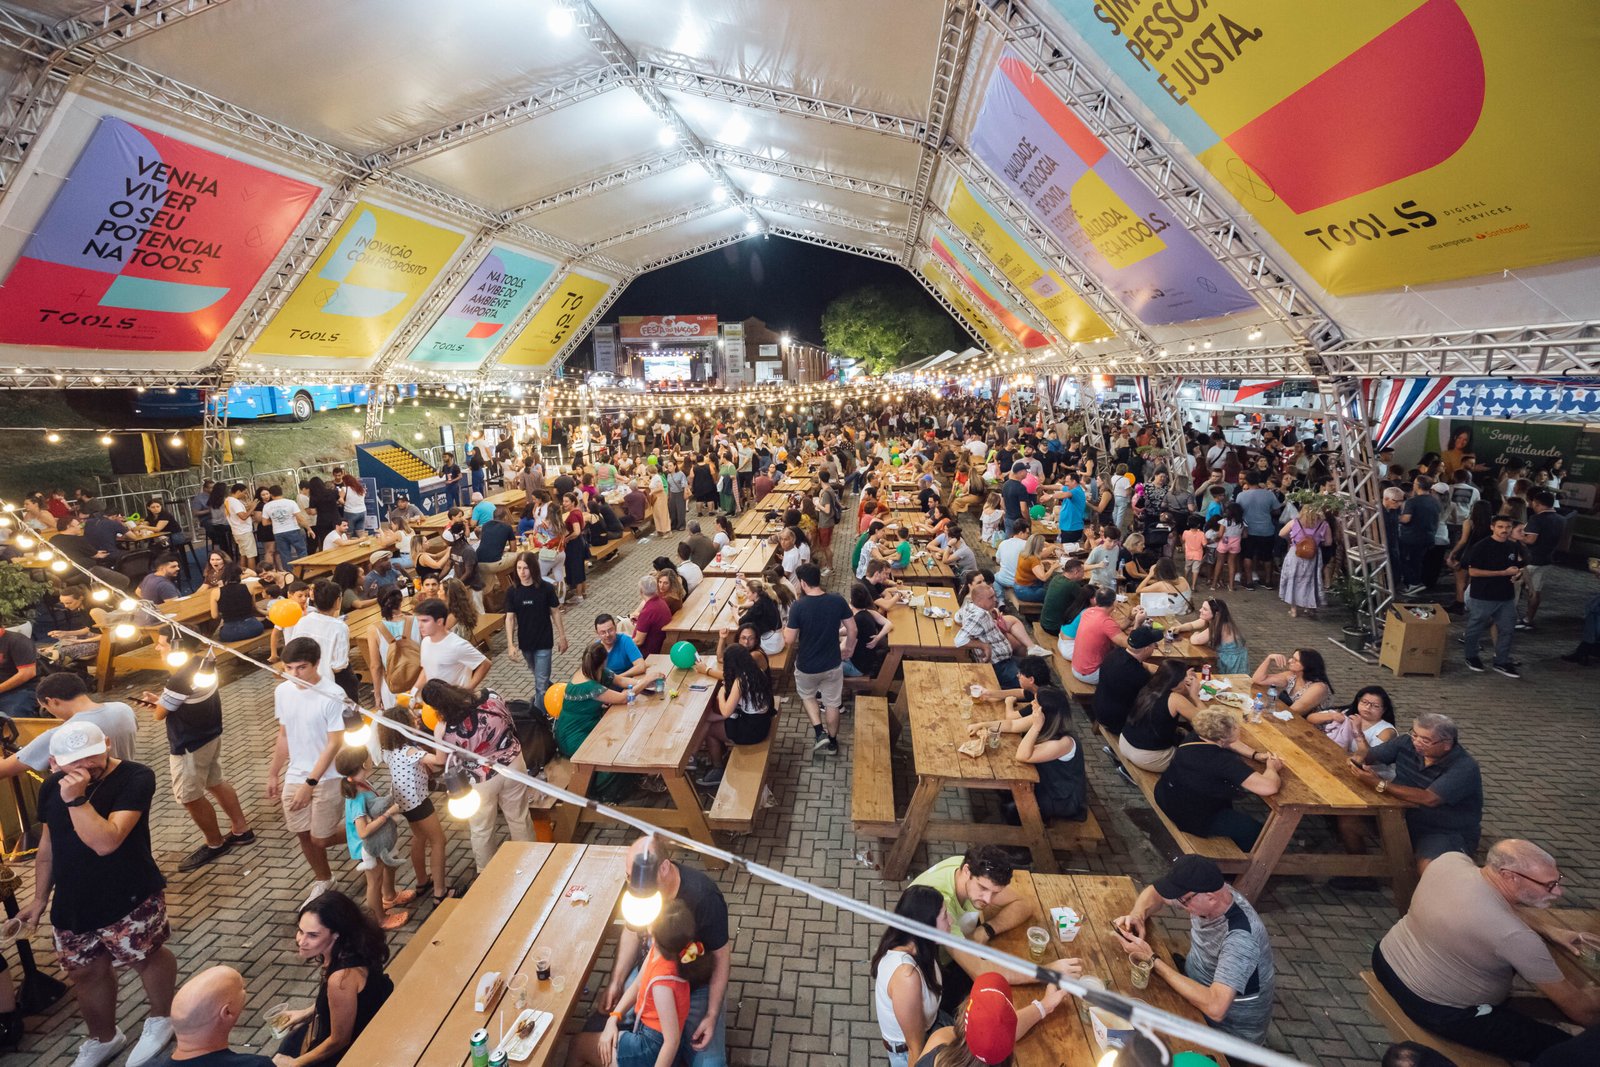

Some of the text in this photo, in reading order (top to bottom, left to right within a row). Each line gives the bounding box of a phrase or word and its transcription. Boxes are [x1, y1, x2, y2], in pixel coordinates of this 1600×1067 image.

[1125, 0, 1208, 72] PESSO
[1157, 13, 1263, 106] E JUSTA.
[1004, 136, 1041, 184] QUALIDADE,
[138, 156, 218, 197] VENHA
[1019, 154, 1060, 199] TECNOLOGIA
[126, 177, 197, 212] VIVER
[1040, 184, 1068, 211] PONTA
[109, 200, 186, 231] O SEU
[1443, 200, 1487, 217] DIGITAL
[1120, 212, 1171, 246] TOOLS.
[1304, 200, 1437, 251] TOOLS
[1484, 223, 1531, 239] Santander
[95, 219, 223, 259] POTENCIAL
[355, 235, 413, 260] INOVAÇÃO
[82, 239, 204, 274] NA TOOLS.
[347, 250, 428, 276] COM PROPÓSITO
[486, 270, 502, 283] NA
[469, 294, 511, 308] AMBIENTE
[477, 282, 518, 298] A VIBE DO
[40, 309, 138, 330] TOOLS
[641, 326, 665, 335] FESTA
[289, 328, 341, 342] TOOLS
[432, 341, 465, 352] TOOLS
[1505, 444, 1563, 457] cuidando
